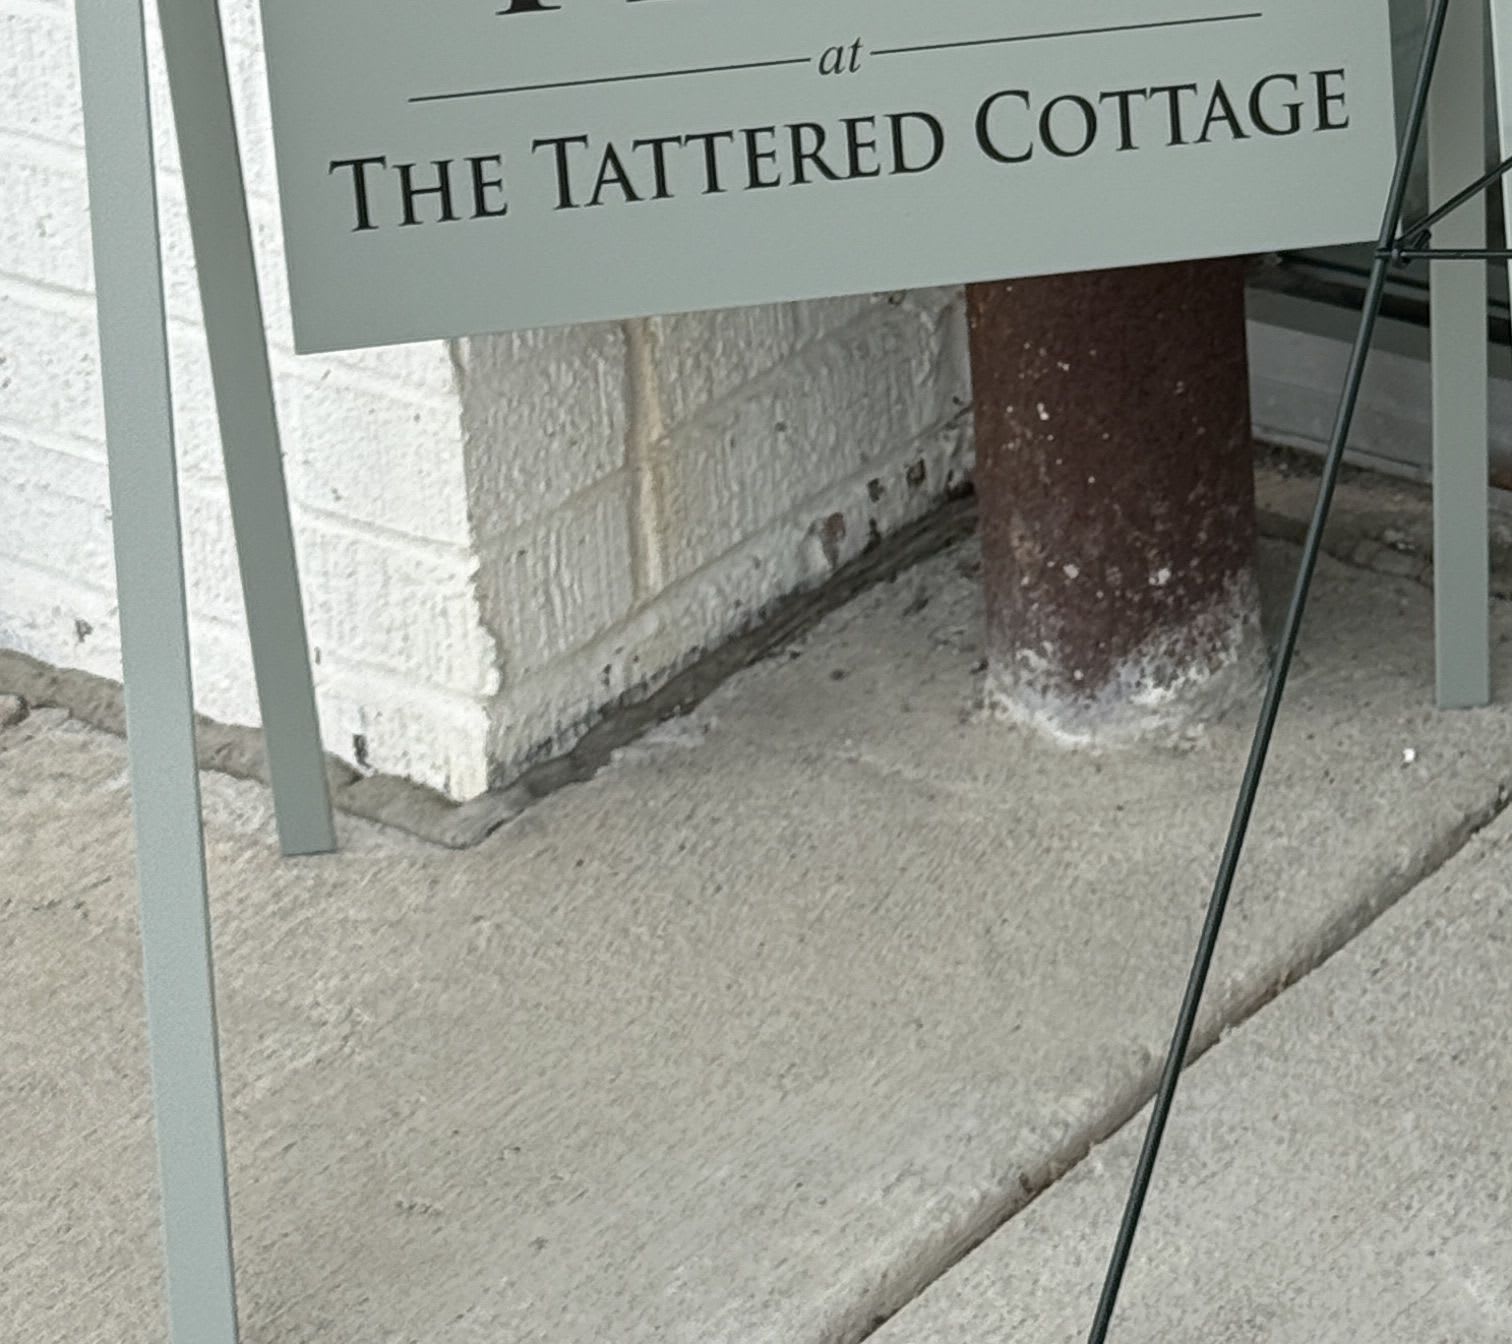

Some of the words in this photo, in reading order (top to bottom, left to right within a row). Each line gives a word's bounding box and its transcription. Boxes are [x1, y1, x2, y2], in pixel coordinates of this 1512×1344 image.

[818, 37, 864, 76] at
[328, 154, 509, 232] THE
[531, 111, 945, 210] TATTERED
[975, 67, 1350, 164] COTTAGE
